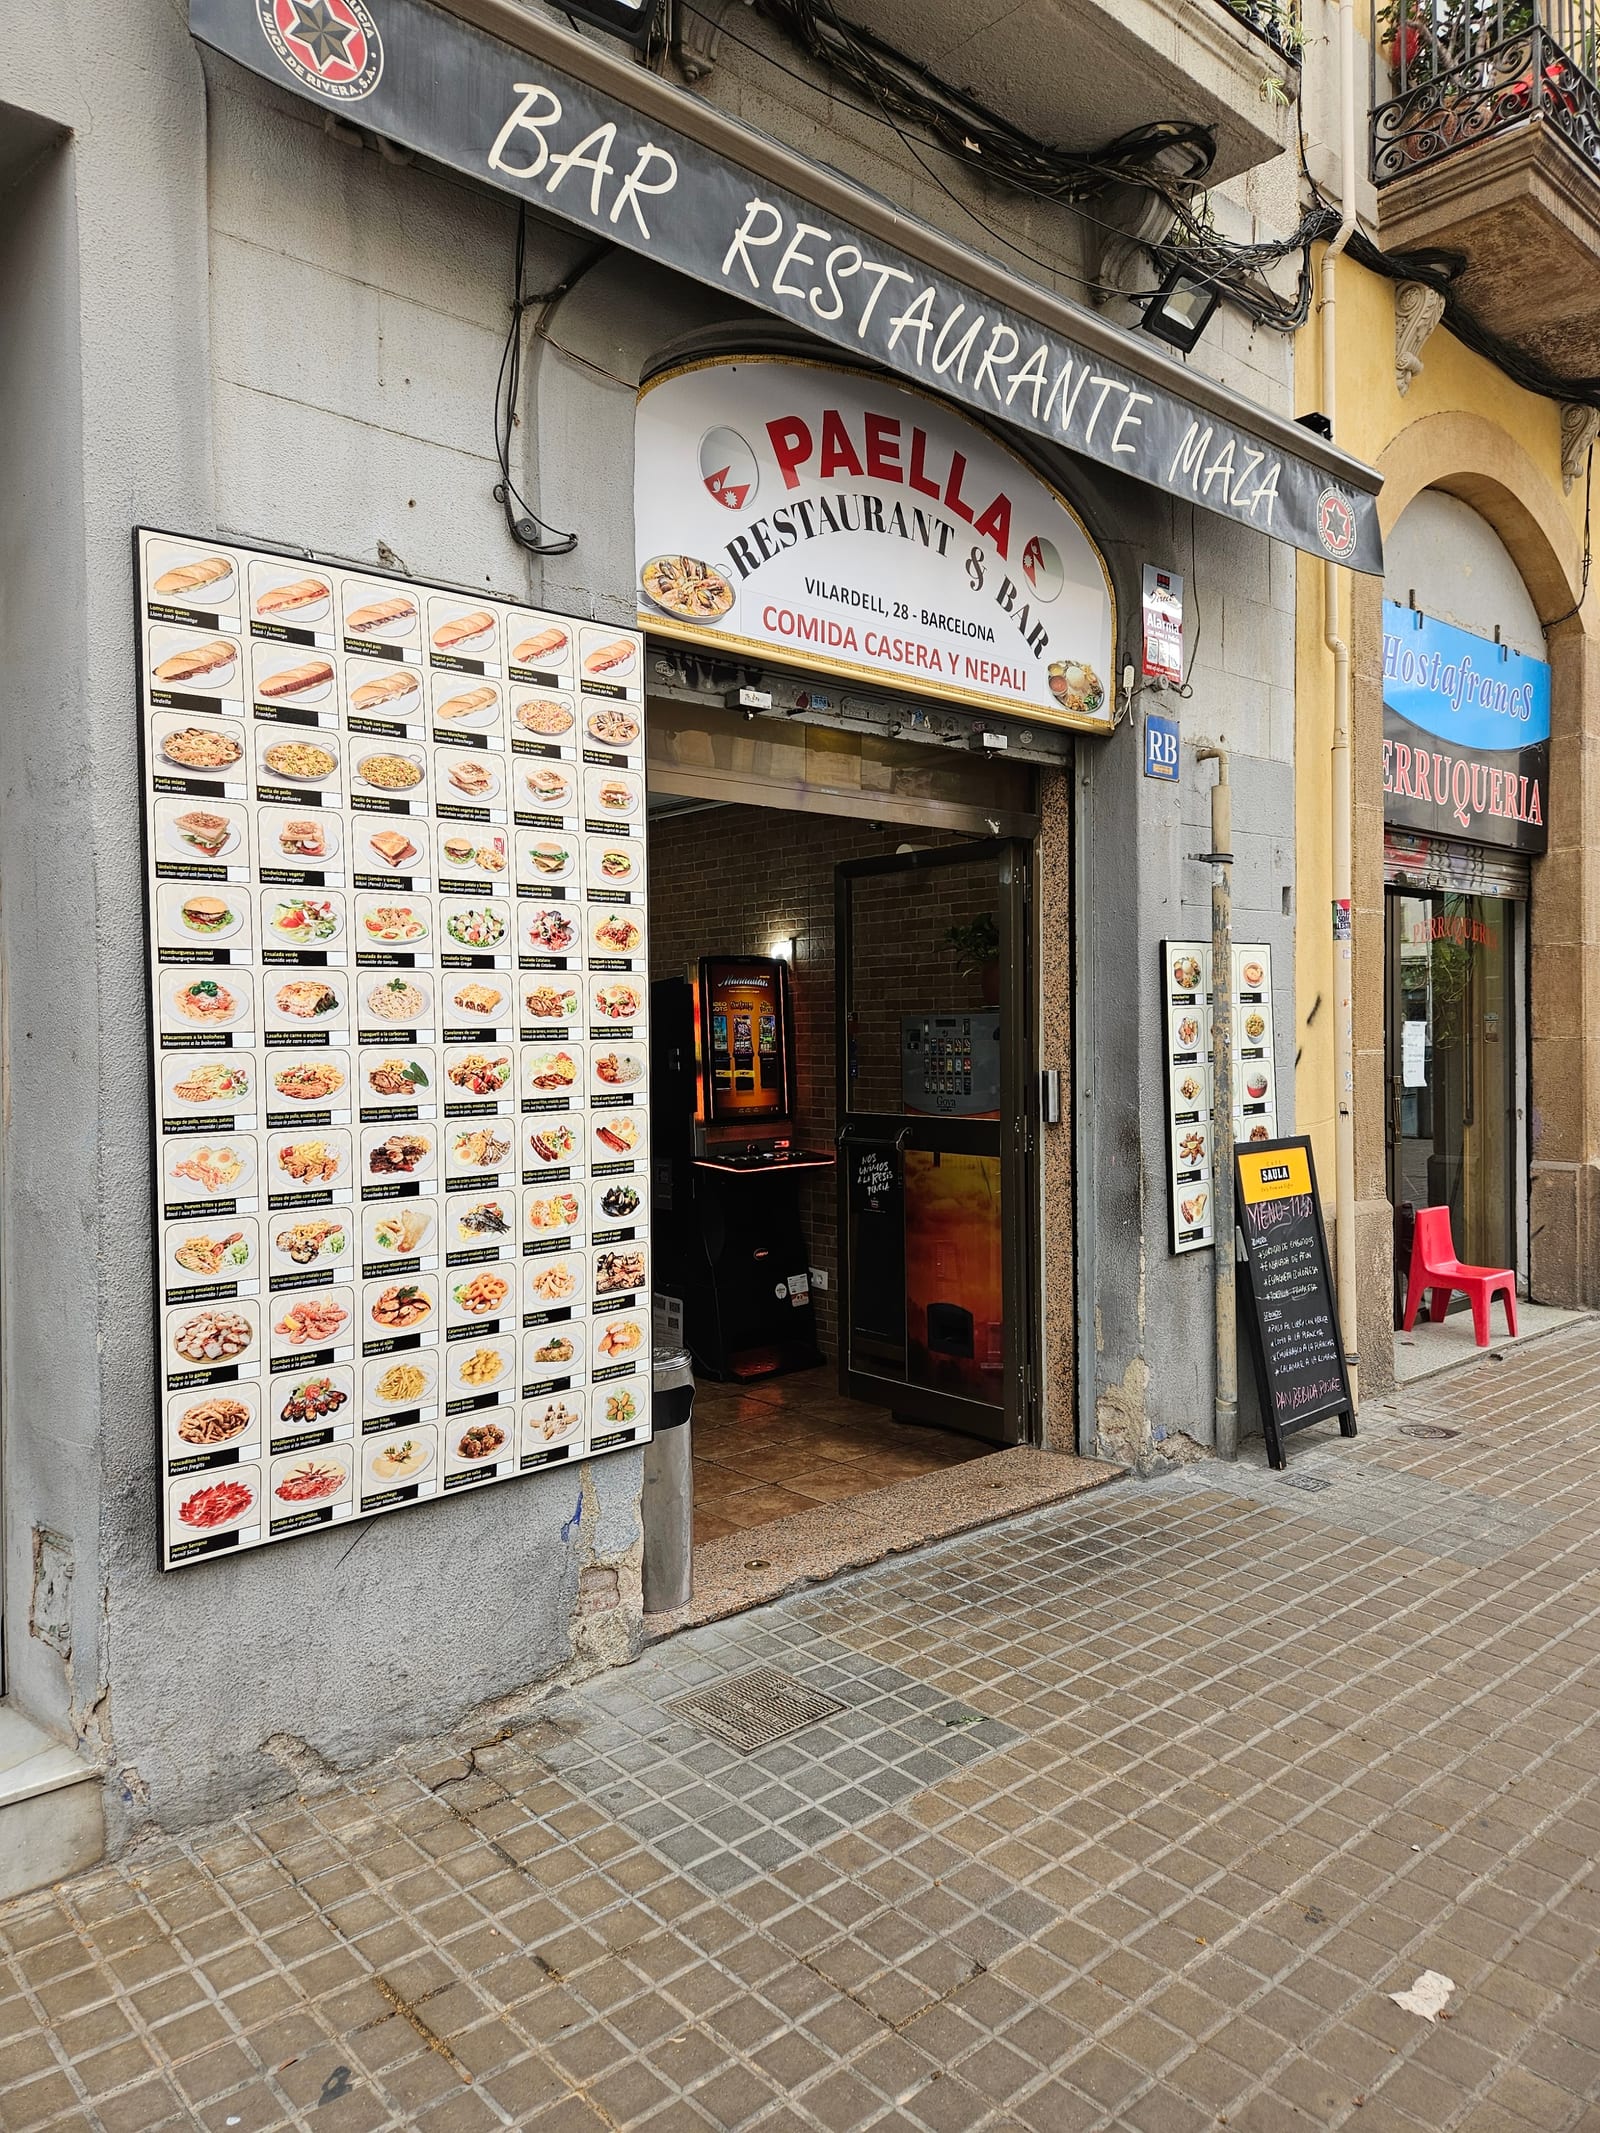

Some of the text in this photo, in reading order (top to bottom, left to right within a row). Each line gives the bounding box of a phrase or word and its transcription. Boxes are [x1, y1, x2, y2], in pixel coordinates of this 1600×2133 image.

[262, 11, 288, 56] HIJOS
[286, 56, 305, 77] DE
[346, 0, 375, 39] LICIA
[488, 83, 1282, 526] BAR RESTAURANTE MAZA
[765, 409, 1014, 561] PAELLA
[724, 493, 1050, 660] RESTAURANT & BAR
[804, 577, 889, 619] VILARDELL,
[893, 601, 909, 620] 28
[920, 609, 995, 644] BARCELONA
[1147, 613, 1179, 634] Alarma
[762, 605, 1027, 692] COMIDA CASERA Y NEPALI
[1148, 729, 1178, 765] RB
[1383, 739, 1543, 829] ERRUQUERIA
[861, 1153, 877, 1165] NOS
[1262, 1166, 1289, 1182] SAULA
